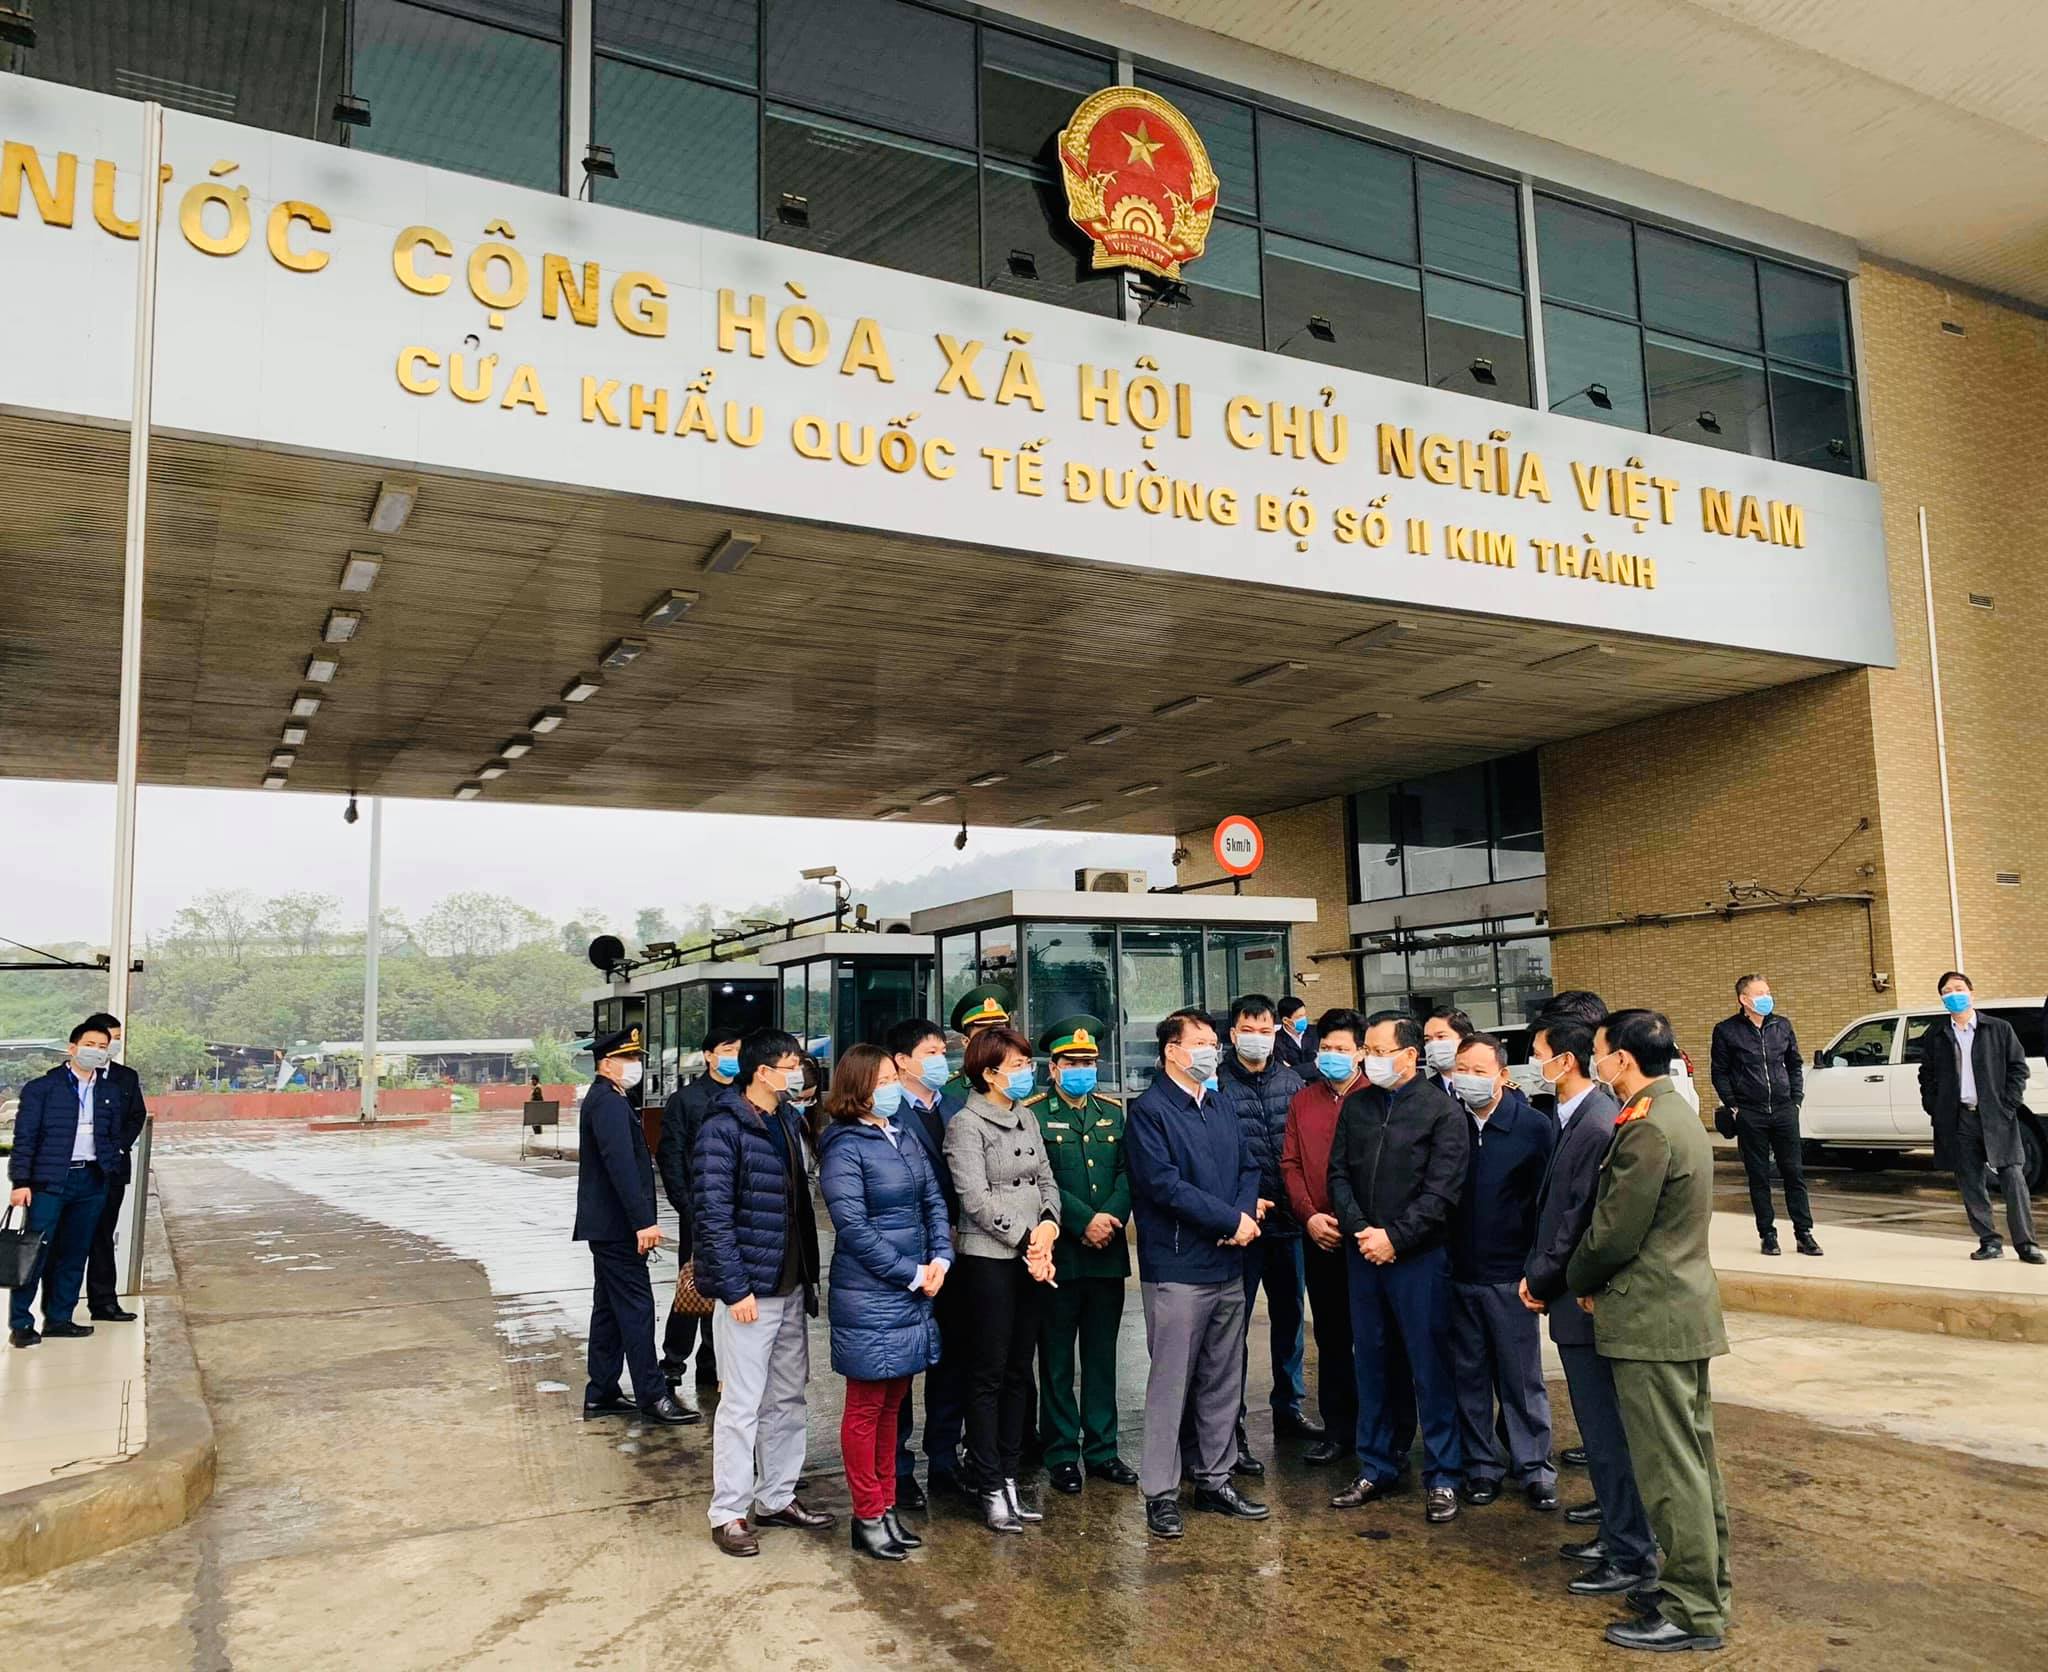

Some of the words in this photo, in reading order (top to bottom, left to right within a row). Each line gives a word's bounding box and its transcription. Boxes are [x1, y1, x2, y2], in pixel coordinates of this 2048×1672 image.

[393, 218, 669, 340] CỘNG
[717, 281, 895, 384] HÒA
[934, 328, 1046, 412] XÃ
[1078, 355, 1193, 450] HỘI
[1224, 385, 1349, 465] CHỦ
[1376, 423, 1552, 504] NGHĨA
[1570, 456, 1680, 535] VIỆT
[1700, 487, 1807, 549] NAM
[396, 333, 548, 416] CỬA
[581, 367, 764, 449] KHẨU
[791, 411, 956, 481] QUỐC
[980, 437, 1049, 497] TẾ
[1063, 460, 1240, 527] ĐƯỜNG
[1256, 486, 1317, 552] BỘ
[1333, 494, 1392, 549] SỐ
[1406, 518, 1432, 556] II
[1444, 525, 1517, 570] KIM
[1530, 533, 1657, 590] THÀNH
